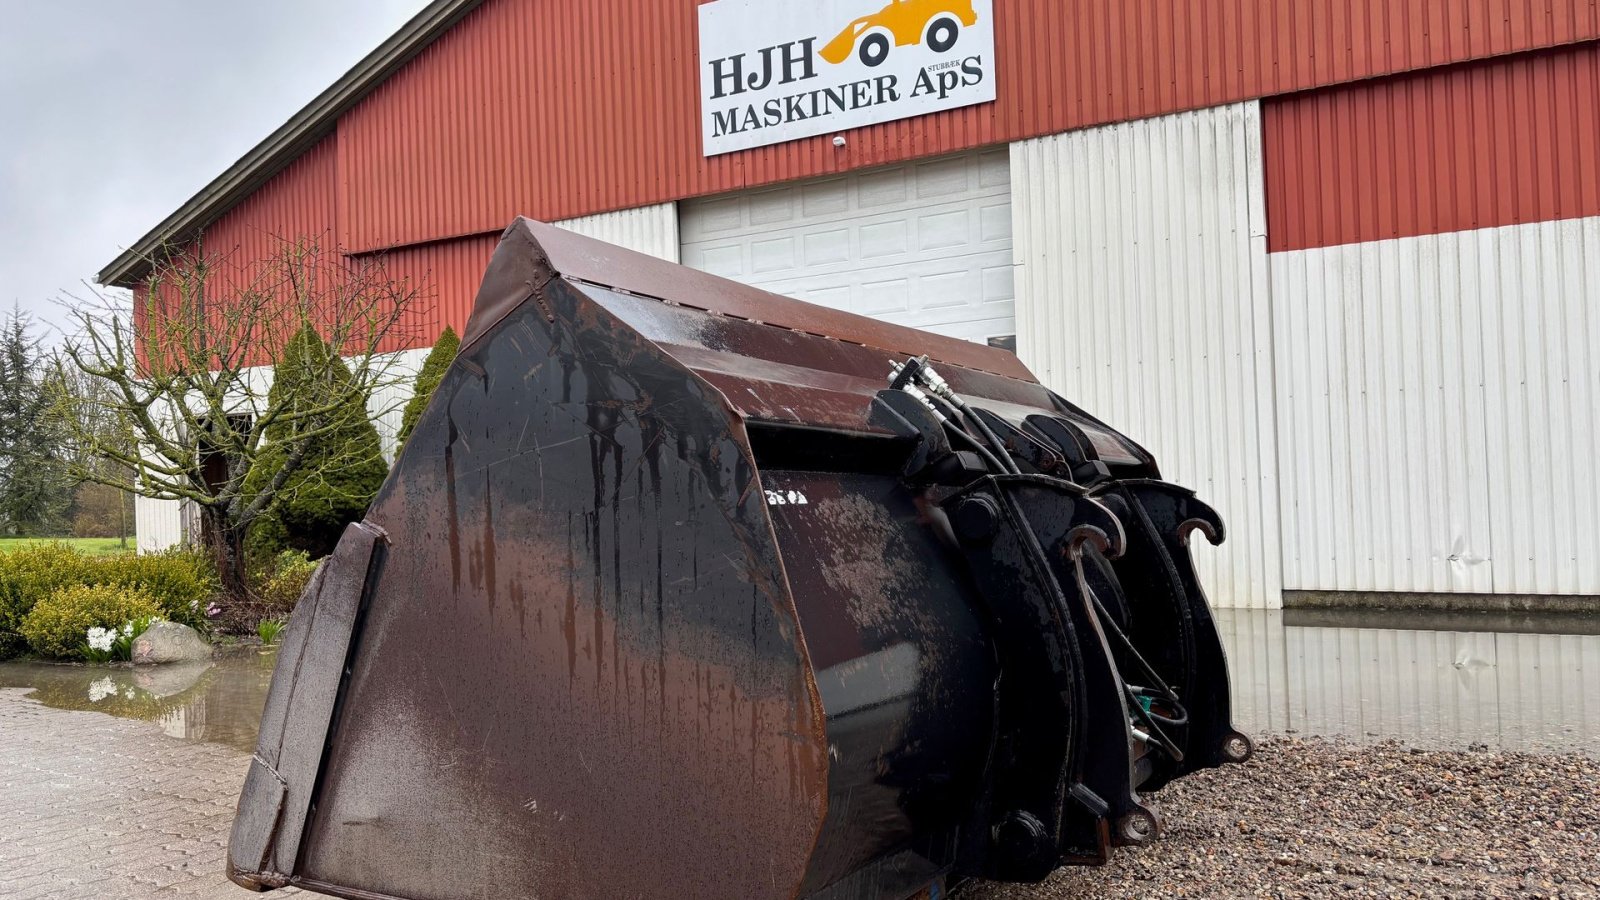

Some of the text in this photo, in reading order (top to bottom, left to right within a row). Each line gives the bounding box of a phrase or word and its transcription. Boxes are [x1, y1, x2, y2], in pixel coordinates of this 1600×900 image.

[708, 36, 818, 100] HJH
[711, 54, 983, 138] MASKINER ApS
